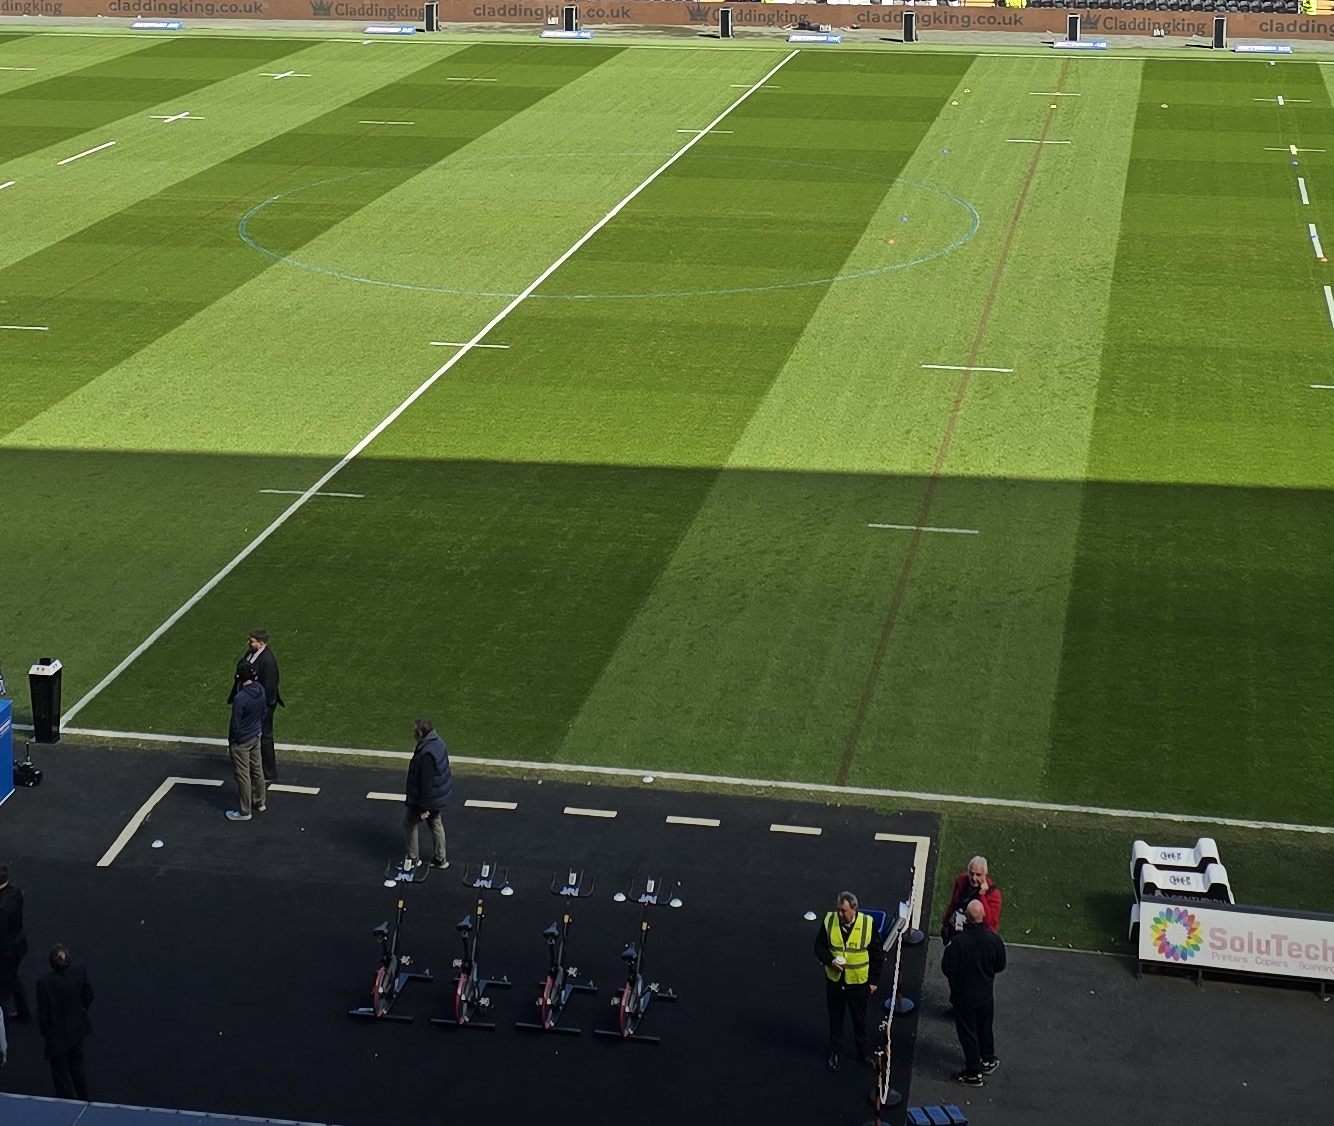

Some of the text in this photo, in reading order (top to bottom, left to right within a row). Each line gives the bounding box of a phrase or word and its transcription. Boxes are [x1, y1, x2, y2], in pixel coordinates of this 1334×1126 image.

[109, 0, 263, 16] claddingking.co.uk
[335, 2, 425, 20] Claddingking
[713, 8, 808, 24] Cddingking
[1103, 15, 1206, 34] Claddingking
[1212, 953, 1248, 964] Printers
[1255, 957, 1288, 968] Copiers
